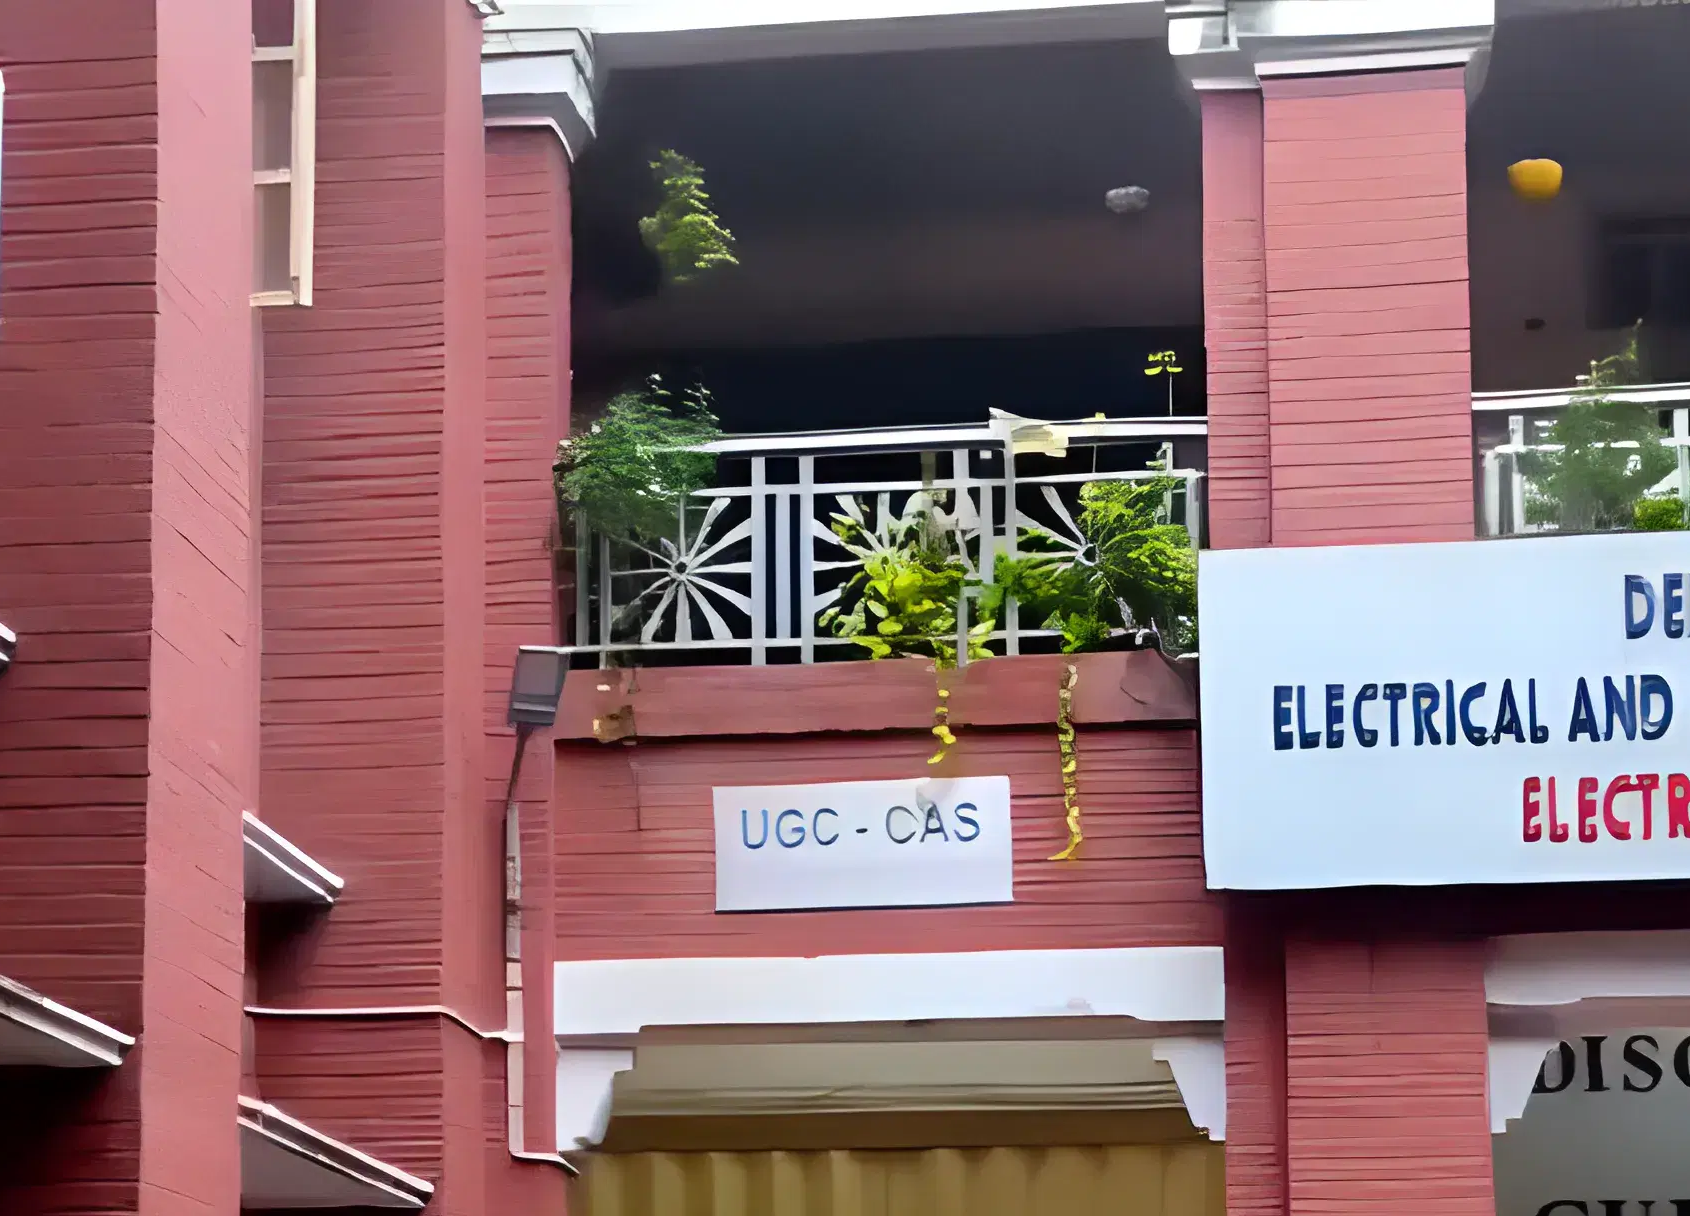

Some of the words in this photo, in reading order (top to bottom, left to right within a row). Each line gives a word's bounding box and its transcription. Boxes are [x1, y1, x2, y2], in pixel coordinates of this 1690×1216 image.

[1272, 677, 1550, 751] ELECTRICAL
[1567, 673, 1674, 743] AND
[741, 807, 840, 850] UGC
[885, 801, 981, 845] CAS
